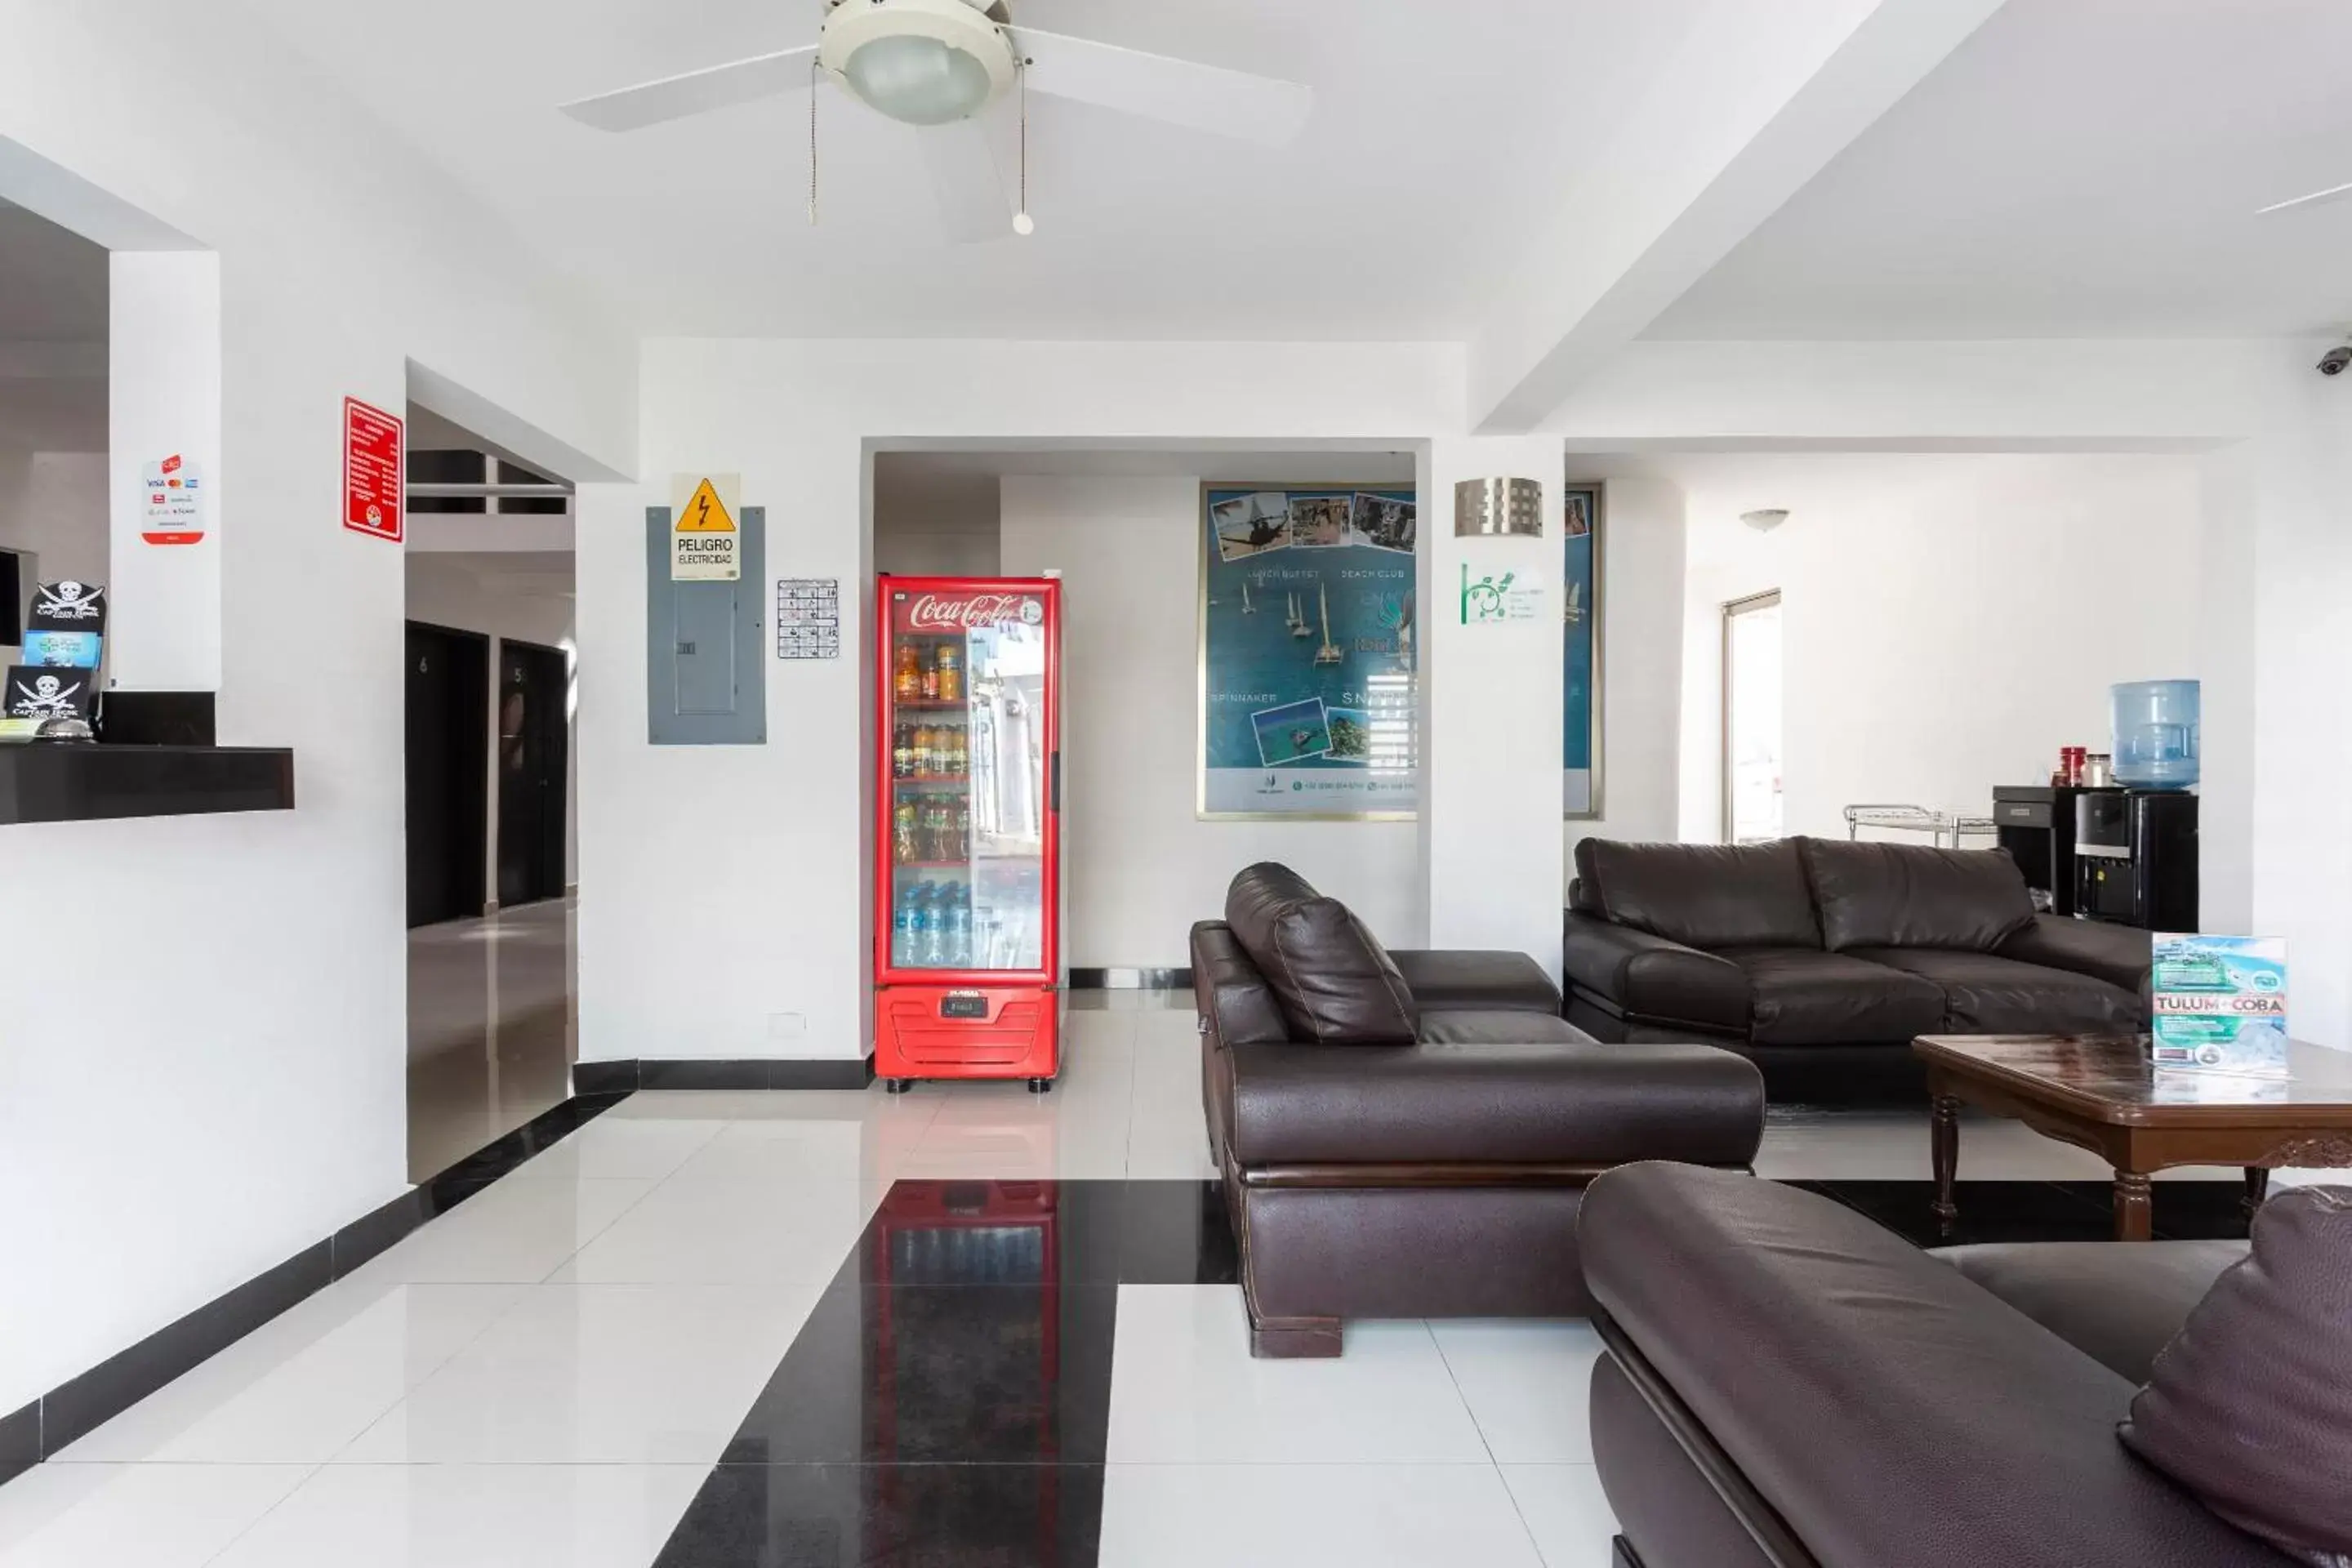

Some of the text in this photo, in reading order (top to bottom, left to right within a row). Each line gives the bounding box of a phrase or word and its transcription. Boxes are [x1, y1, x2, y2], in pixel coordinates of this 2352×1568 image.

[147, 478, 165, 488] VISA
[679, 539, 733, 551] PELIGRO
[679, 555, 733, 564] ELECTRICIDAD
[1342, 570, 1405, 578] BEACH CLUB
[420, 656, 427, 672] 6
[514, 667, 522, 683] 5
[2157, 996, 2283, 1012] TULUM COBA
